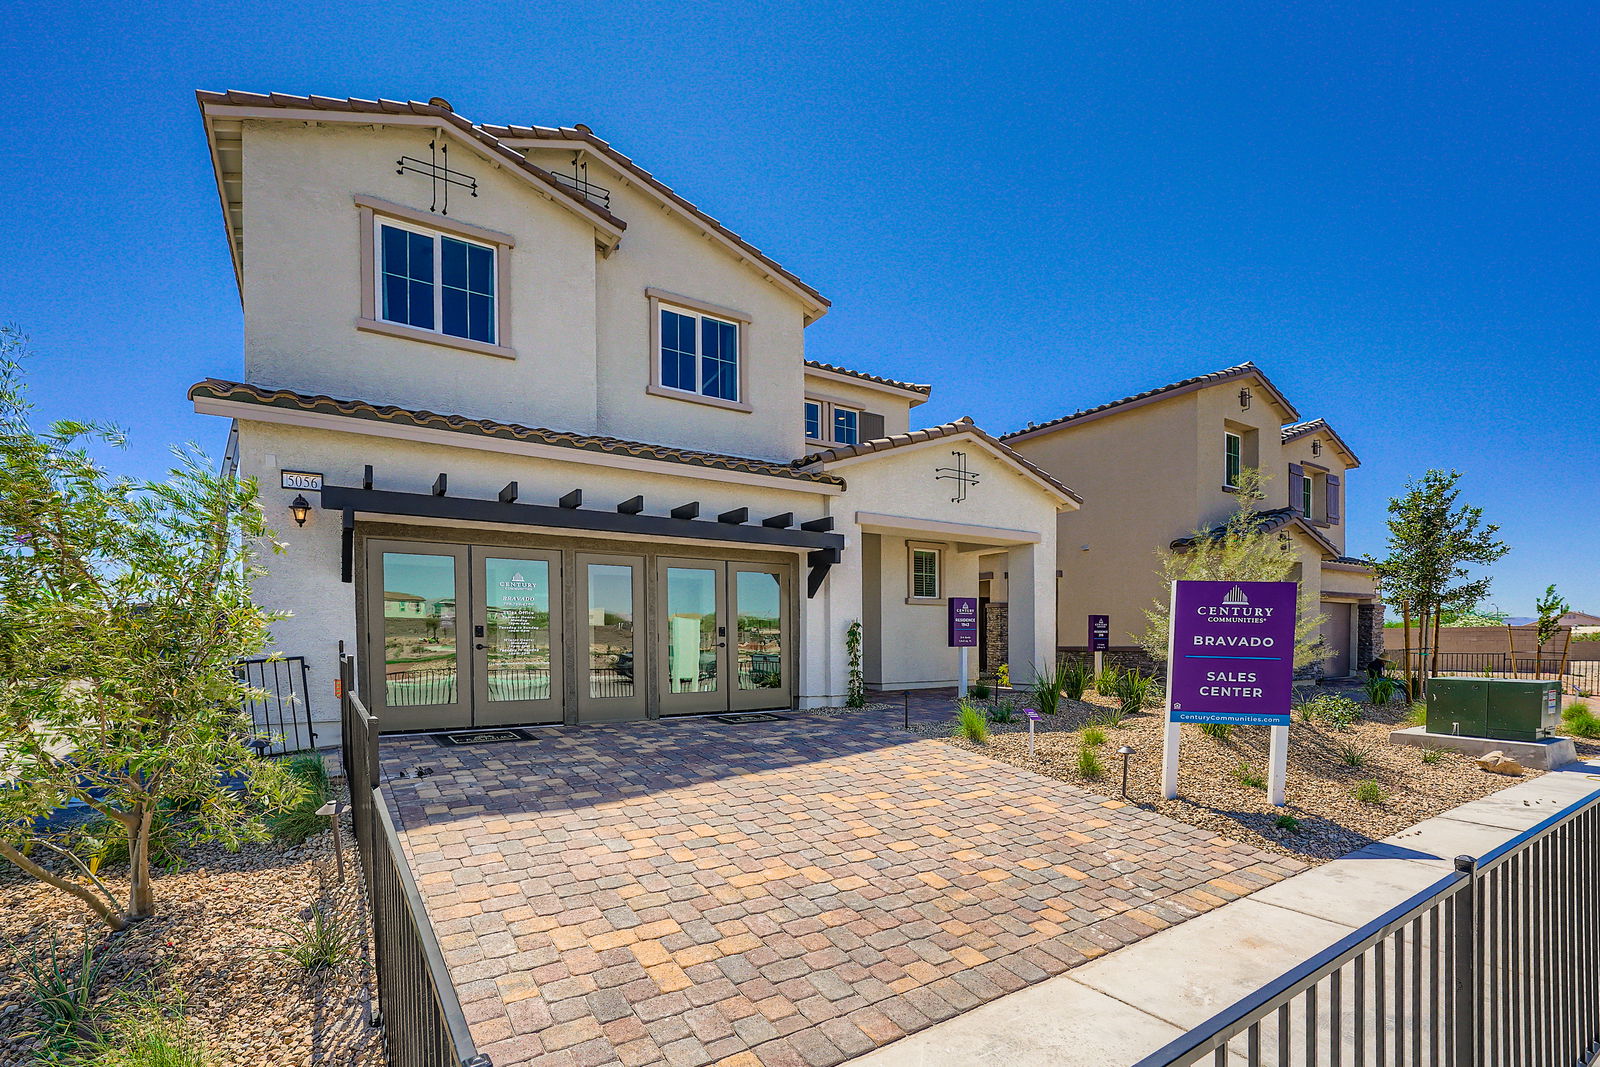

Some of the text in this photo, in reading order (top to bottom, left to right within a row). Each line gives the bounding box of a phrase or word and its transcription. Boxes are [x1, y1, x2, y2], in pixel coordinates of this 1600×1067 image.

[288, 475, 318, 489] 5056
[1197, 606, 1274, 617] CENTURY
[1193, 635, 1275, 648] BRAVADO
[1206, 671, 1257, 683] SALES
[1199, 686, 1263, 698] CENTER
[1180, 714, 1280, 723] CenturyCommunities.com
